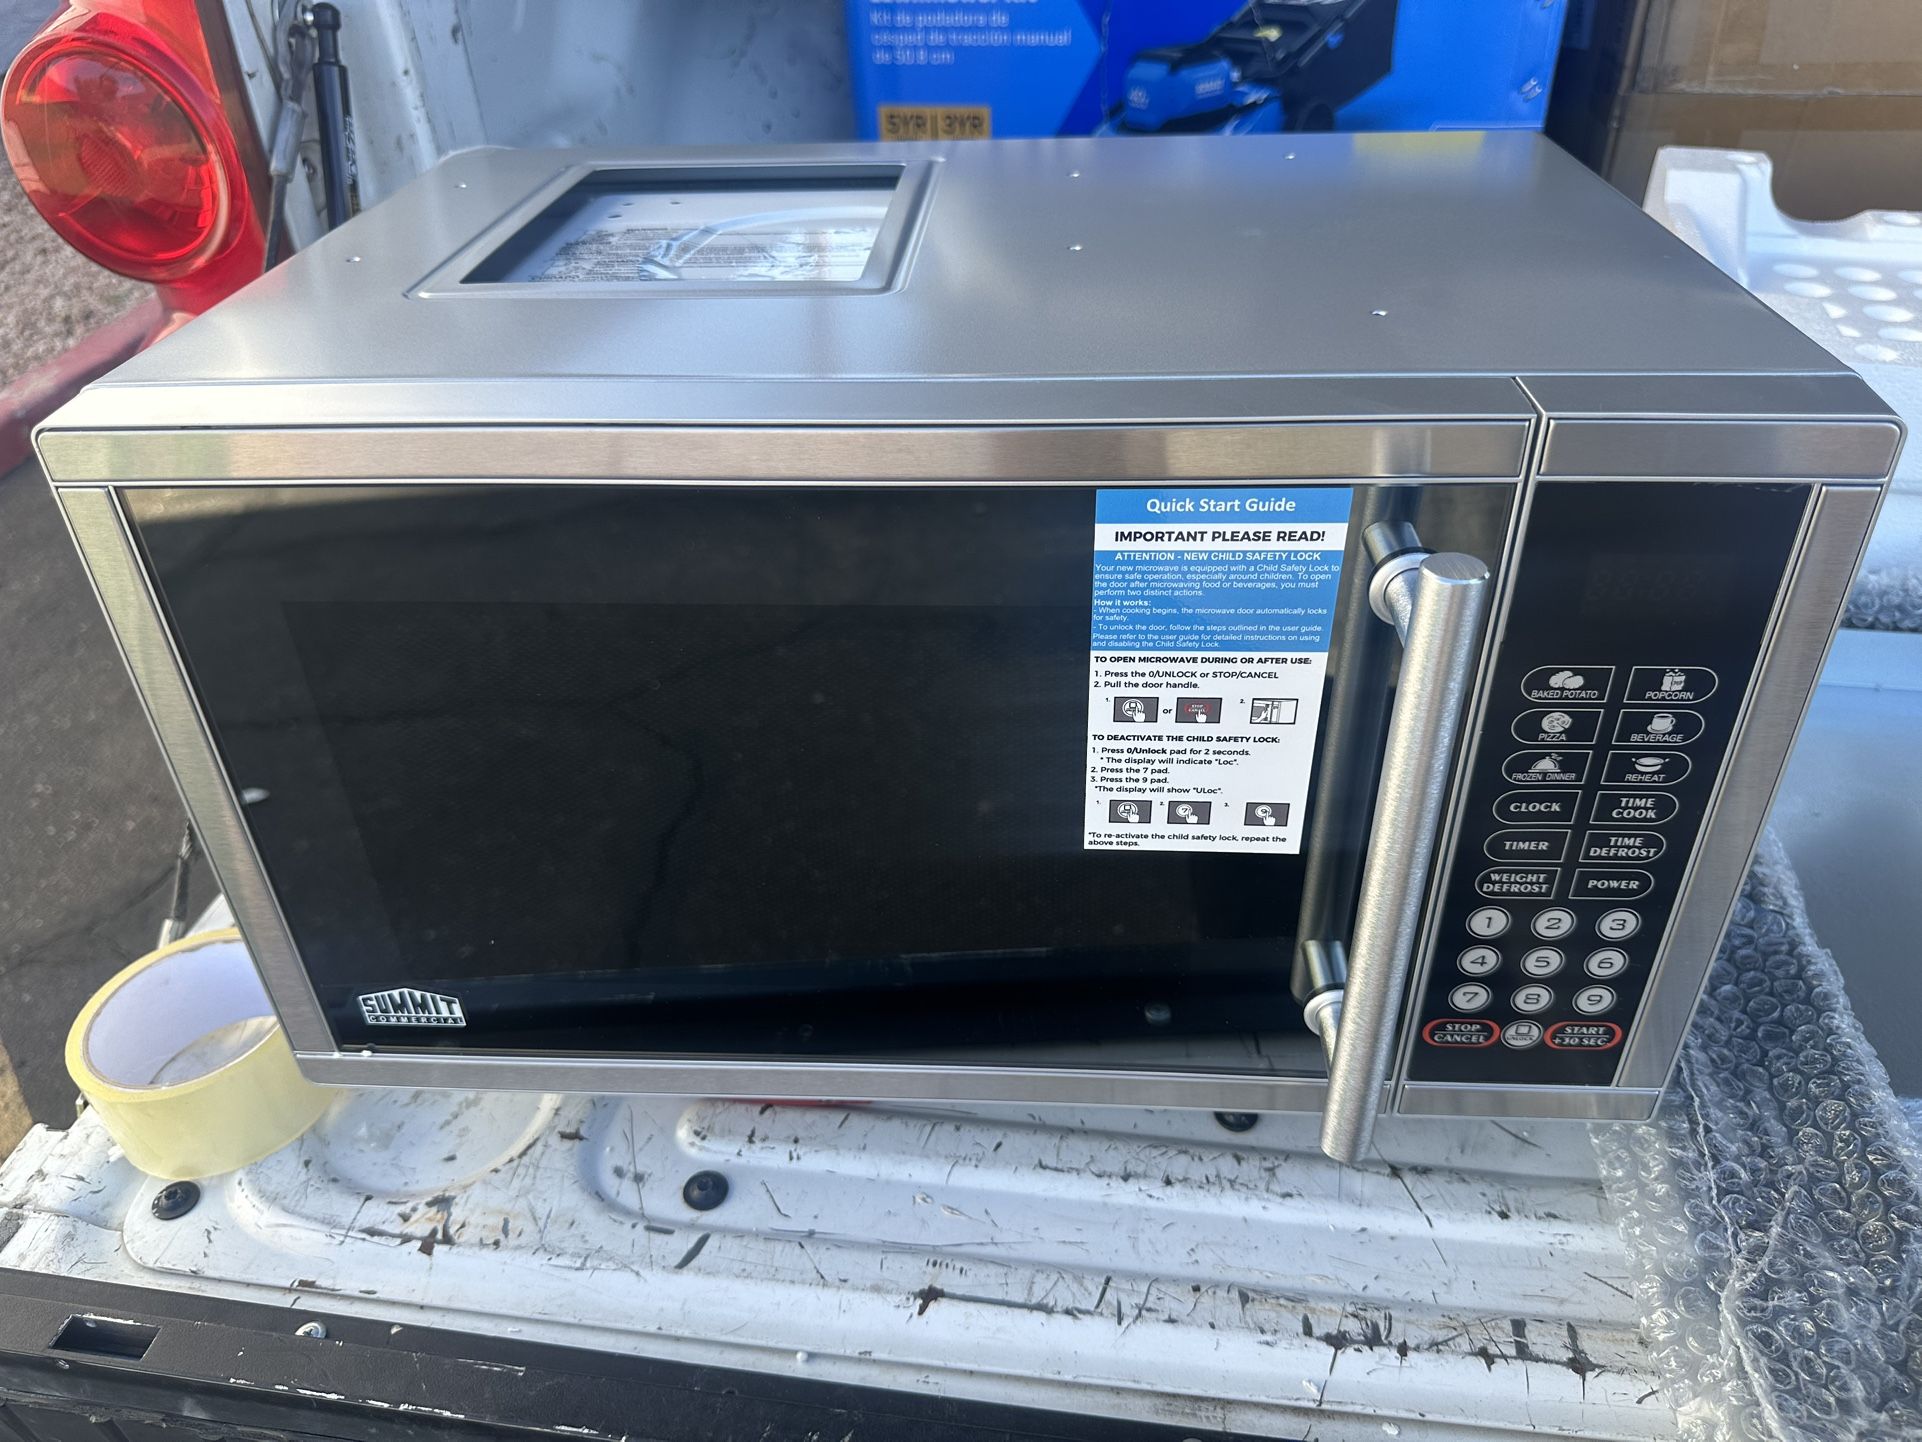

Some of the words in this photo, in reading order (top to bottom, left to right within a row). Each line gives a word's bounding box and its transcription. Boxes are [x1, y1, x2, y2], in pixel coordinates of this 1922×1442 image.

[1147, 498, 1194, 513] Quick
[1199, 498, 1240, 511] Start
[1245, 498, 1295, 511] Guide
[1114, 531, 1207, 542] IMPORTANT
[1212, 531, 1272, 542] PLEASE
[1277, 530, 1325, 542] READ!
[1115, 552, 1174, 560] ATTENTION
[1184, 552, 1208, 560] NEW
[1211, 552, 1243, 560] CHILD
[1246, 552, 1288, 560] SAFETY
[1290, 552, 1321, 560] LOCK
[1096, 564, 1114, 572] Your
[1190, 564, 1228, 574] equipped
[1230, 564, 1246, 572] with
[1257, 564, 1278, 572] Child
[1280, 564, 1306, 574] Safety
[1309, 564, 1329, 572] Lock
[1144, 573, 1184, 581] operation,
[1186, 572, 1226, 581] especially
[1310, 574, 1331, 582] open
[1150, 581, 1200, 589] microwaving
[1233, 581, 1278, 590] beverages,
[1281, 582, 1295, 590] you
[1148, 670, 1197, 678] 0/UNLOCK
[1212, 671, 1279, 679] STOP/CANCEL
[1531, 690, 1562, 698] BAKED
[1562, 690, 1598, 699] POTATO
[1645, 691, 1694, 700] POPCORN
[1630, 734, 1683, 742] BEVERAGE
[1124, 757, 1156, 765] display
[1512, 773, 1542, 781] FROZEN
[1546, 773, 1575, 781] DINNER
[1624, 774, 1666, 782] REHEAT
[1116, 786, 1147, 794] display
[1510, 802, 1561, 812] CLOCK
[1620, 798, 1655, 807] TIME
[1612, 809, 1656, 818] COOK
[1504, 841, 1549, 850] TIMER
[1609, 837, 1644, 846] TIME
[1589, 848, 1657, 857] DEFROST
[1490, 873, 1547, 883] WEIGHT
[1483, 883, 1549, 893] DEFROST
[1587, 880, 1639, 889] POWER
[1485, 916, 1492, 929] 1
[1544, 917, 1562, 930] 2
[1610, 919, 1626, 931] 3
[1470, 954, 1487, 967] 4
[1534, 956, 1550, 968] 5
[1598, 957, 1613, 969] 6
[1462, 992, 1479, 1003] 7
[1524, 993, 1540, 1004] 8
[1587, 994, 1603, 1005] 9
[362, 990, 458, 1015] SUMMIT
[369, 1016, 464, 1024] COMMERCIAL
[1445, 1023, 1480, 1031] STOP
[1564, 1026, 1606, 1034] START
[1433, 1034, 1486, 1042] CANCEL
[1553, 1037, 1579, 1045] +30
